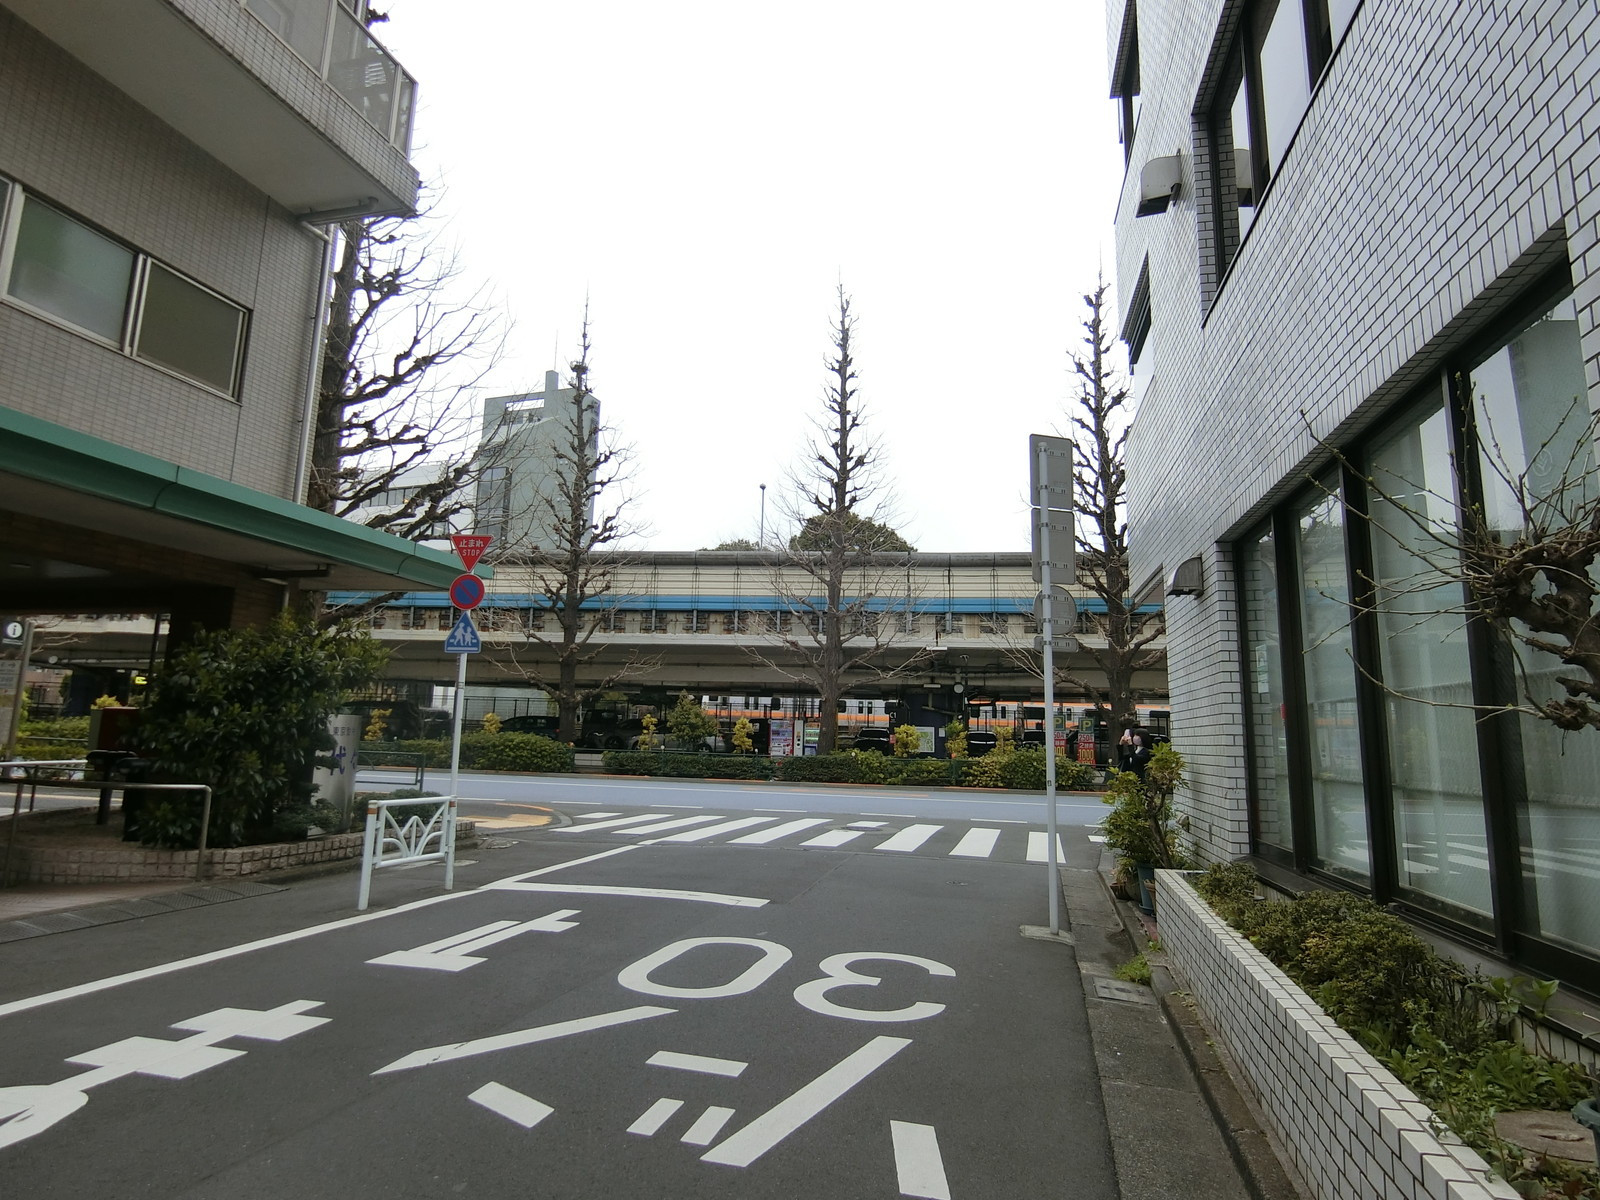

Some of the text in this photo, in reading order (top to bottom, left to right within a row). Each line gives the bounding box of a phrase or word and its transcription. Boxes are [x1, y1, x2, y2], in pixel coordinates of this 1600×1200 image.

[458, 539, 484, 548] 止まれ
[462, 549, 481, 557] STOP
[1082, 720, 1092, 732] P
[617, 936, 957, 1022] 30
